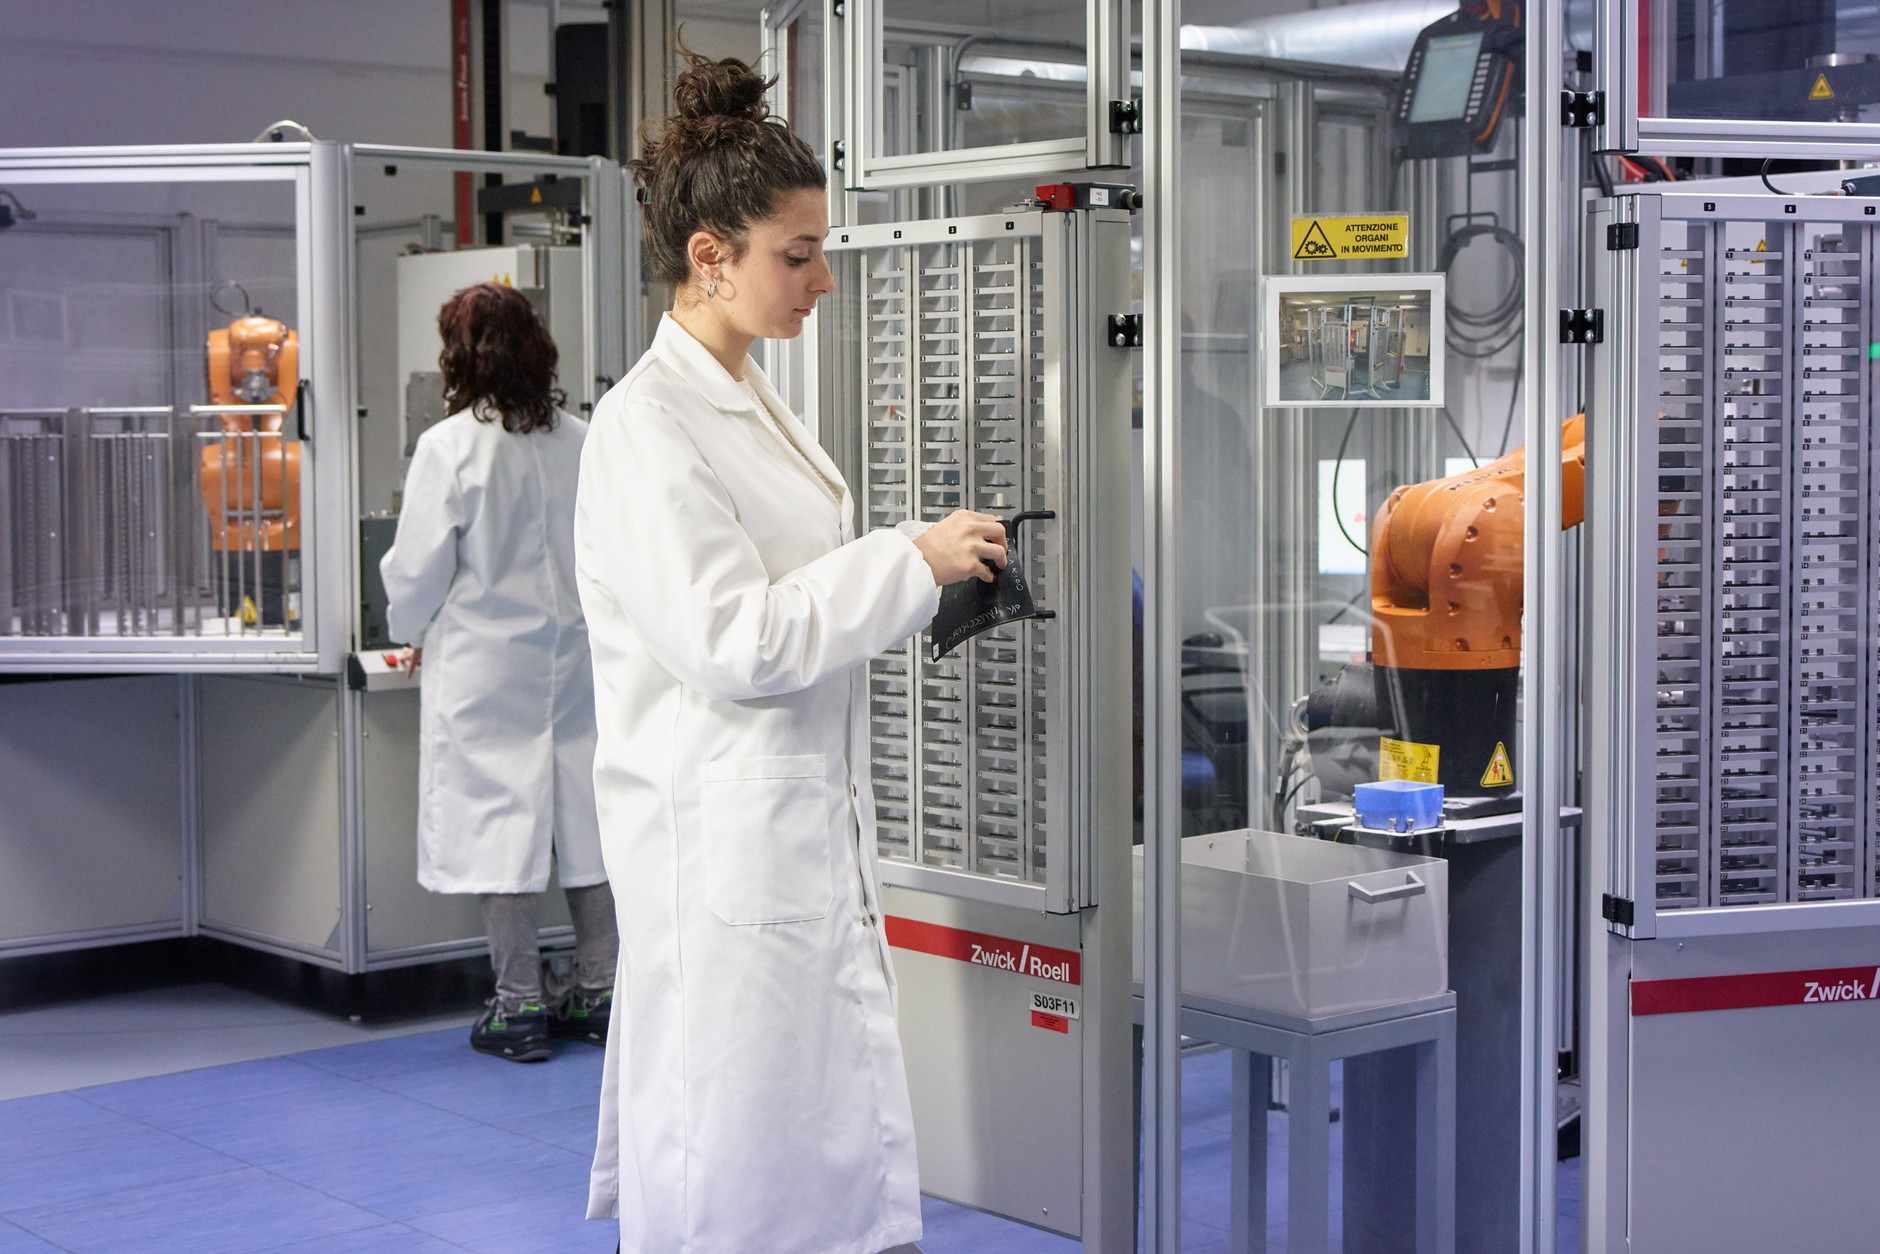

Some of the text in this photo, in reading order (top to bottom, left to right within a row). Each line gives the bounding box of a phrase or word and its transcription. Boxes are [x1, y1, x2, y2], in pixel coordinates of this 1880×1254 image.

[1345, 223, 1399, 232] ATTENZIONE
[1355, 234, 1389, 242] ORGANI
[1341, 244, 1403, 253] IN MOVIMENTO
[1034, 994, 1075, 1015] S03F11
